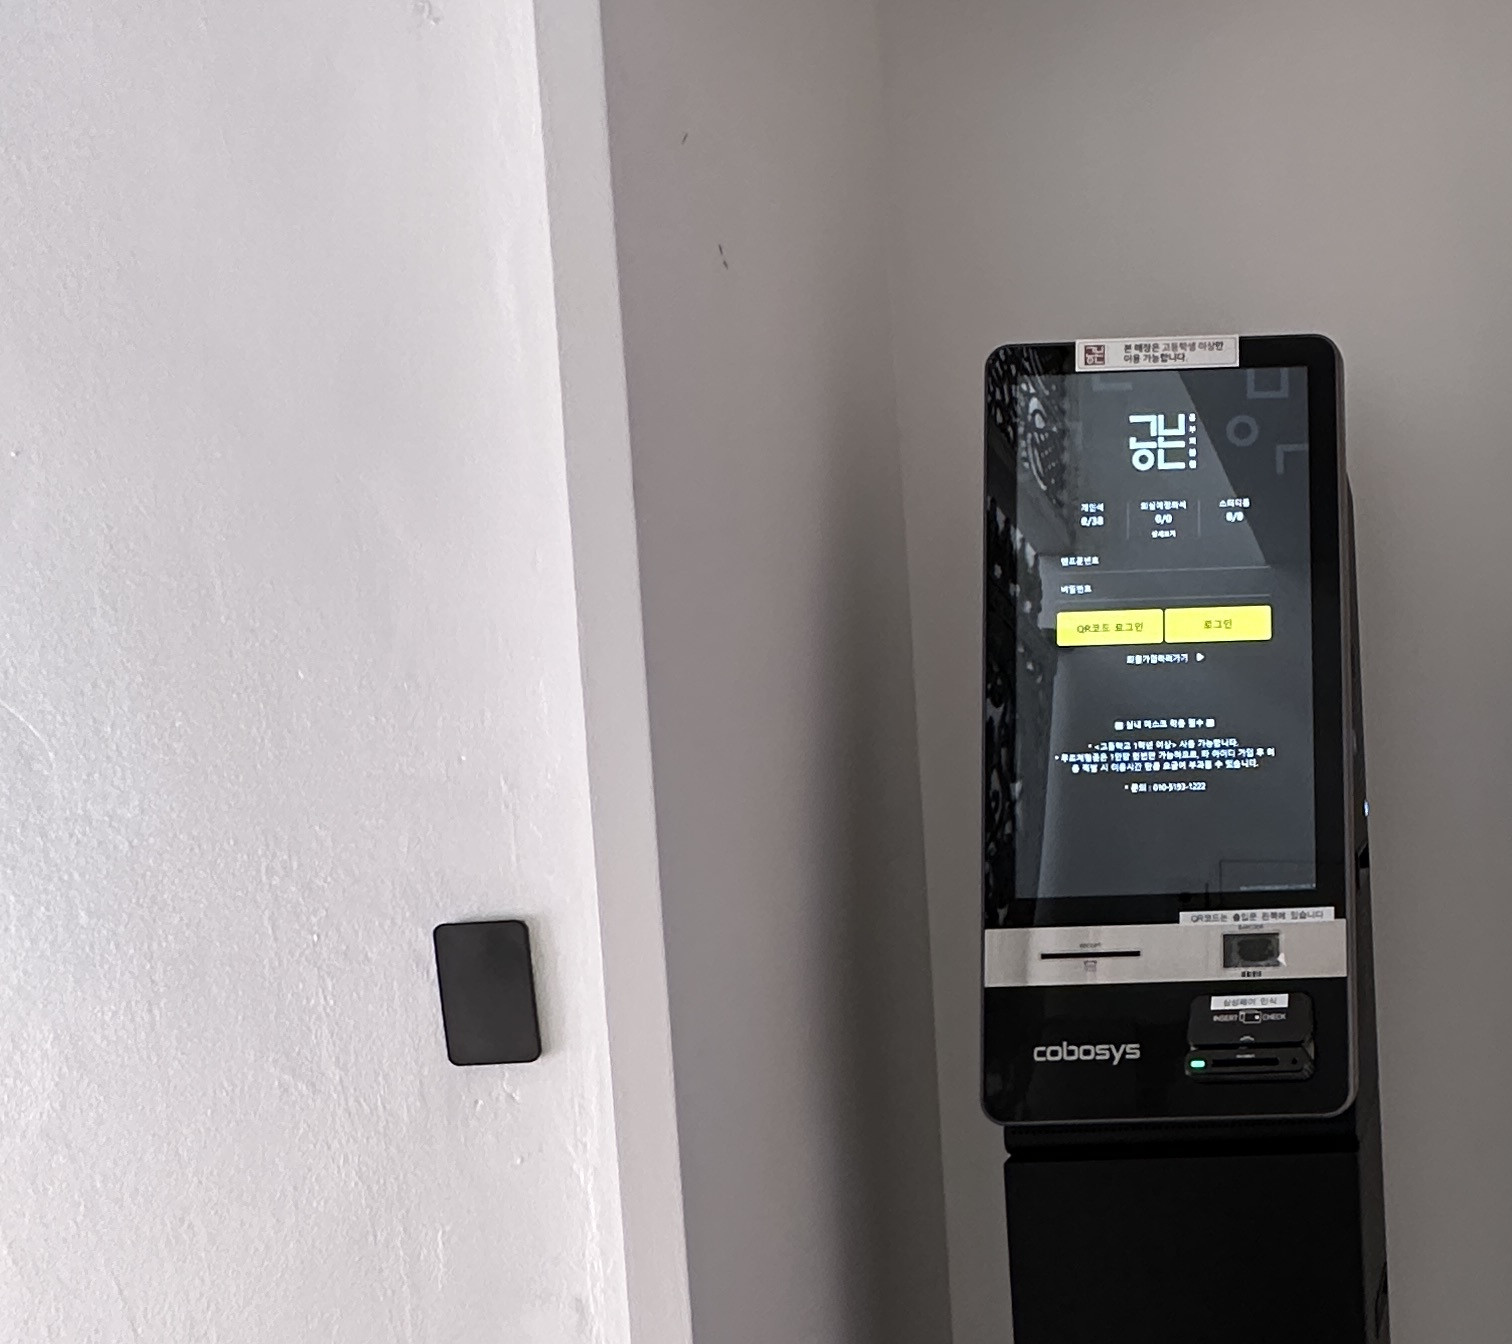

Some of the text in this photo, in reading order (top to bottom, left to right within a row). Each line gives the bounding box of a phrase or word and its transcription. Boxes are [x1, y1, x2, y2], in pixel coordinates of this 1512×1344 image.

[1162, 342, 1196, 352] 고등학생
[1198, 341, 1224, 351] 이상만
[1124, 355, 1140, 364] 이용
[1077, 622, 1144, 634] QR코드 로그인
[1204, 618, 1233, 630] 로그인
[1126, 720, 1142, 730] 실내
[1144, 719, 1168, 729] 마스크
[1188, 718, 1204, 728] 필수
[1232, 912, 1258, 922] 출입문
[1290, 910, 1324, 920] 있습니다
[1224, 996, 1278, 1007] 삼성페이 인식
[1033, 1041, 1141, 1065] cobosys
